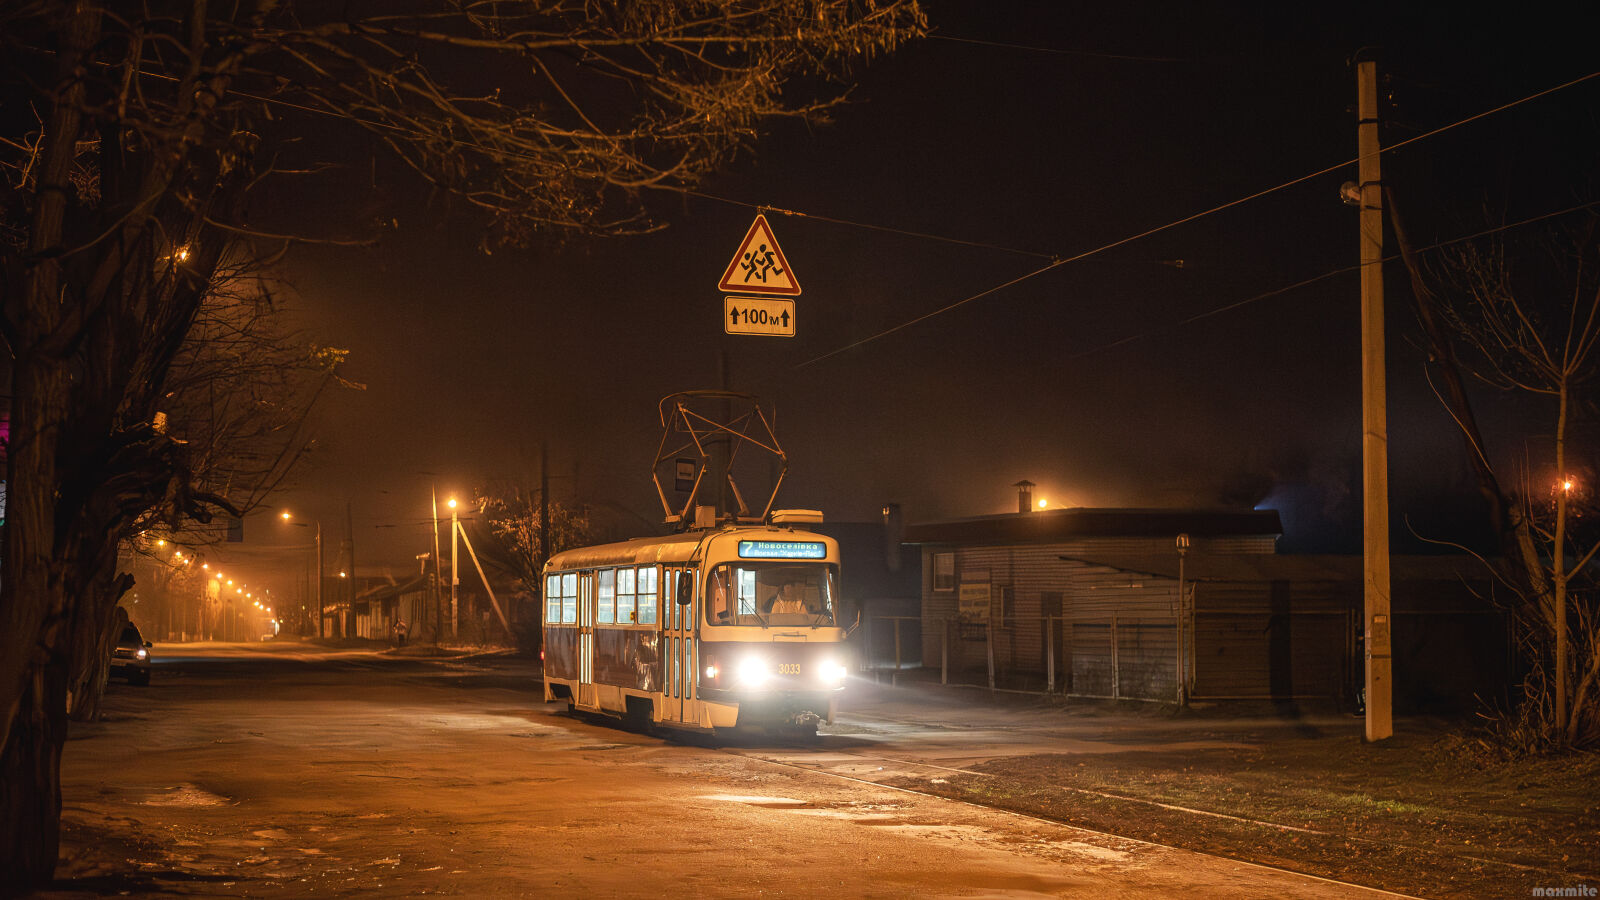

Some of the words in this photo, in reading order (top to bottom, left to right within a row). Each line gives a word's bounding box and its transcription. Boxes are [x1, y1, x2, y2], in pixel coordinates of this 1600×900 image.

[742, 541, 753, 556] 7
[758, 541, 818, 550] Новоселівка
[778, 663, 801, 675] 3033
